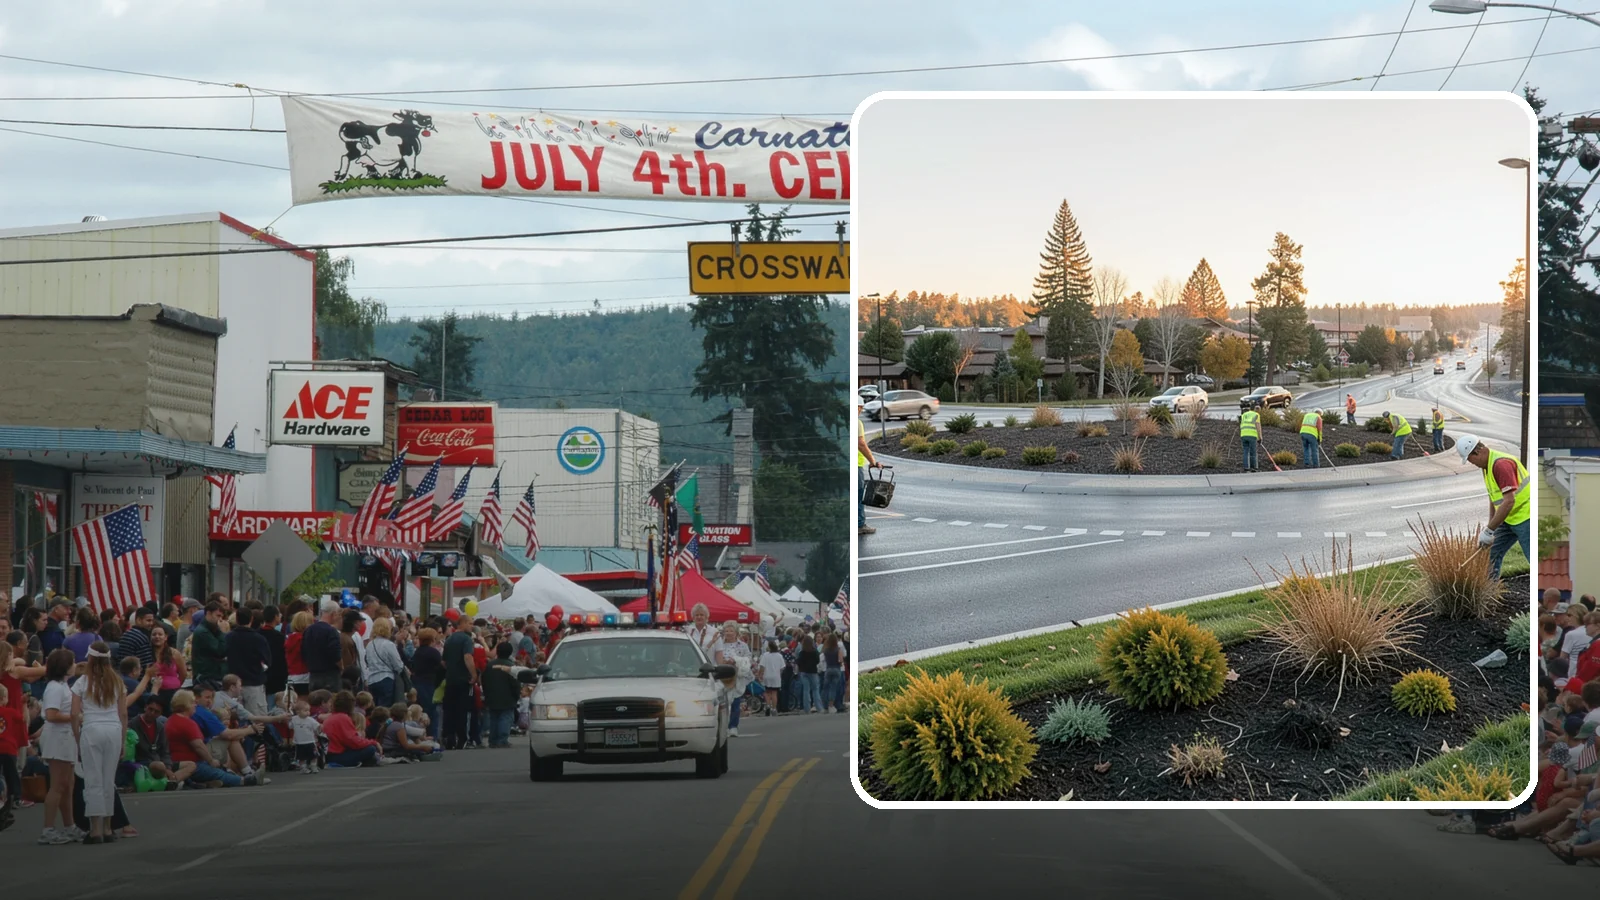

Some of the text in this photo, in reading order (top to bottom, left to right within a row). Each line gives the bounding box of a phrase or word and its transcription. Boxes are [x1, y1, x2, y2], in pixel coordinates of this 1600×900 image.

[481, 141, 605, 192] JULY
[632, 150, 747, 198] 4th.
[697, 254, 850, 280] CROSSWA
[283, 380, 374, 420] ACE
[406, 409, 485, 422] CEDAR LOG
[283, 421, 371, 436] Hardware
[353, 467, 387, 479] Simpl
[95, 485, 125, 495] Vincent
[126, 486, 136, 495] de
[137, 486, 155, 495] Paul
[688, 526, 741, 535] CRNATION
